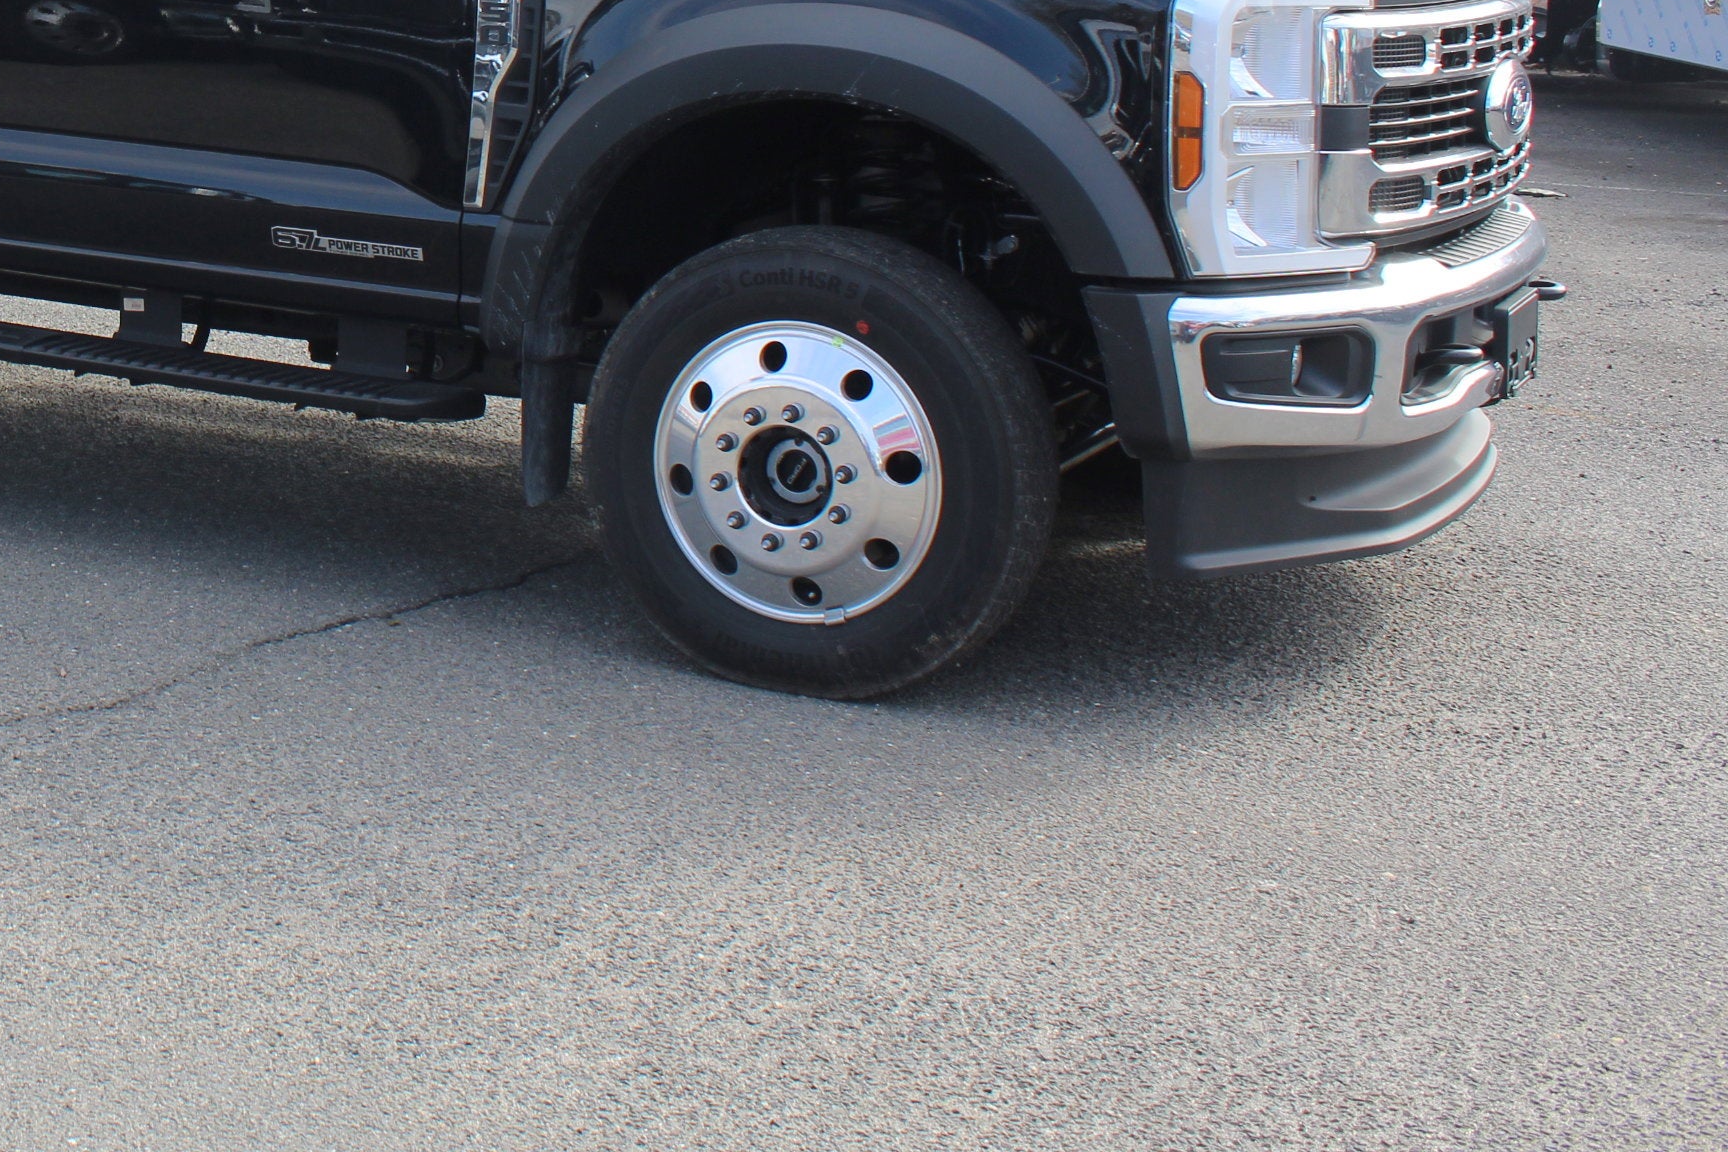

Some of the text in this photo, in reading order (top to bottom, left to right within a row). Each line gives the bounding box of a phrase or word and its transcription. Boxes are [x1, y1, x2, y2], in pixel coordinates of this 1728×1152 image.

[328, 239, 369, 253] POWER
[372, 244, 419, 259] STROKE
[739, 267, 794, 288] Conti
